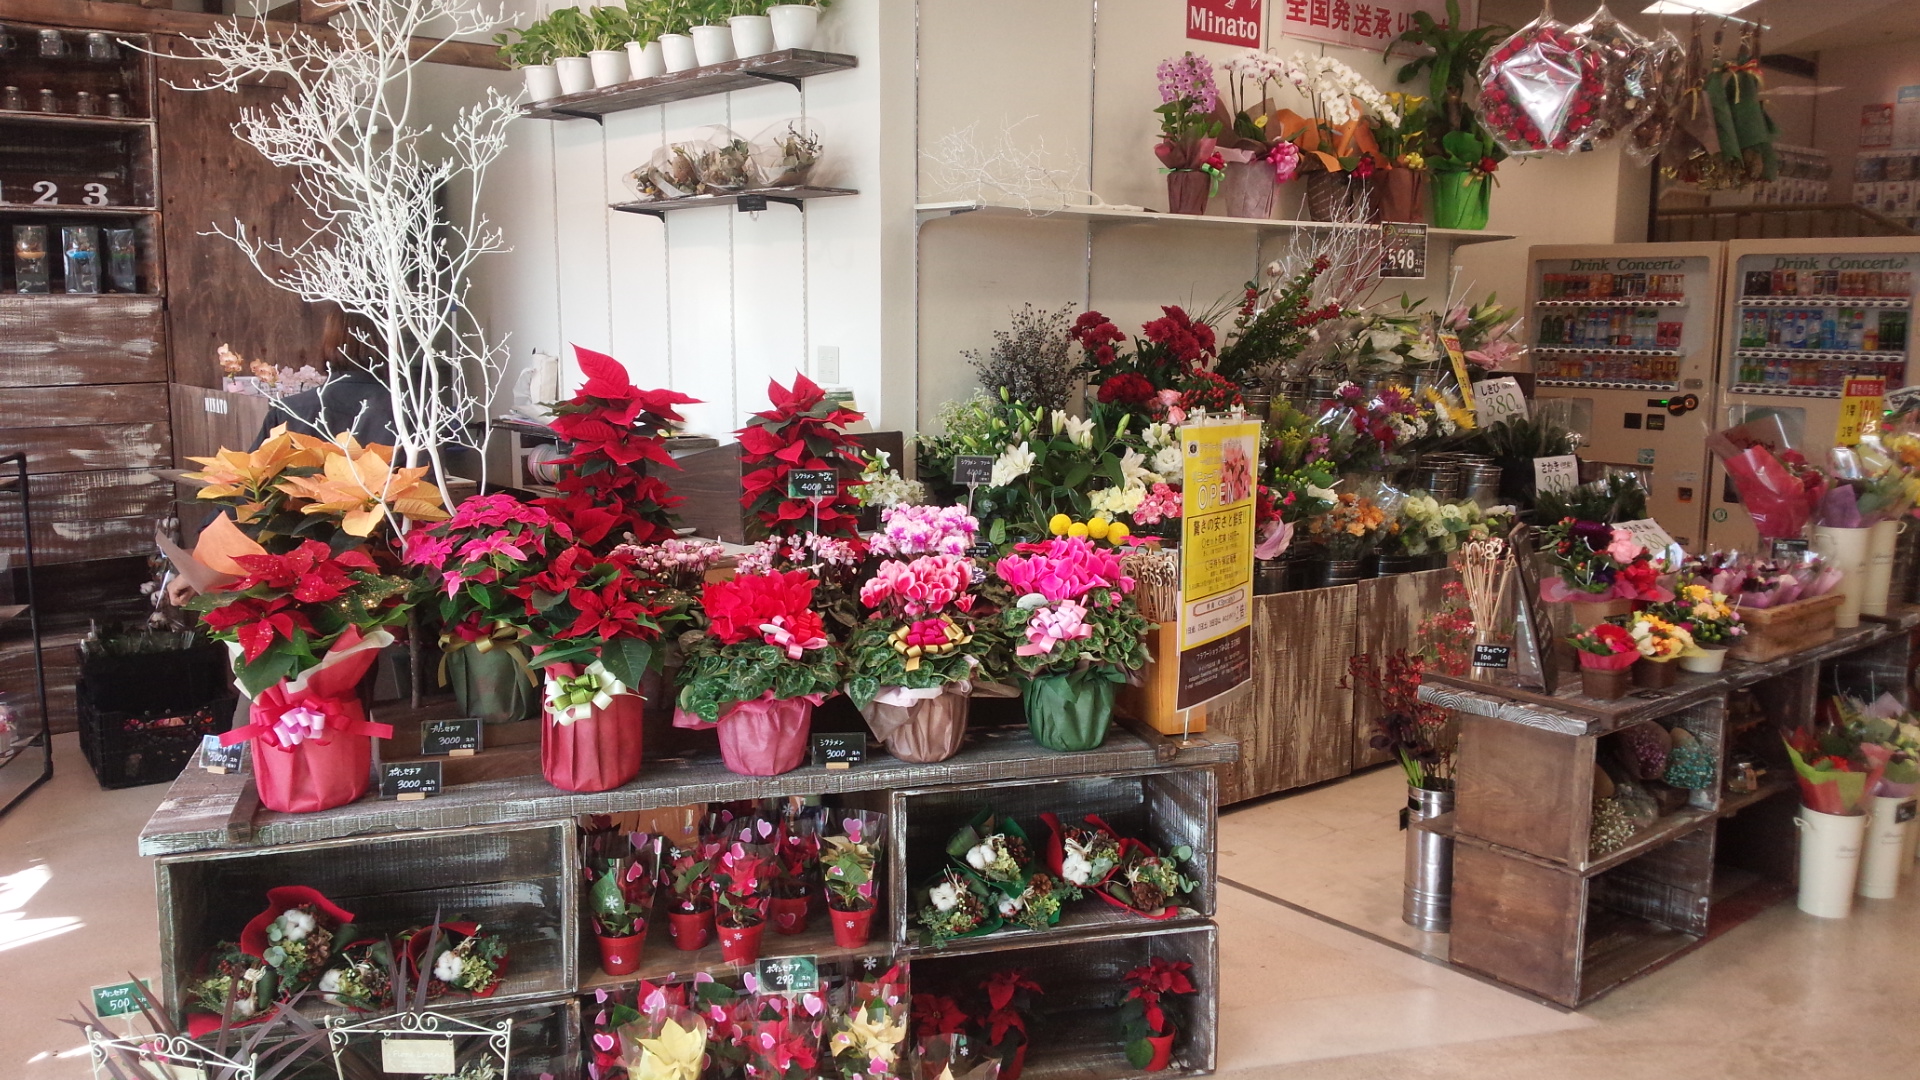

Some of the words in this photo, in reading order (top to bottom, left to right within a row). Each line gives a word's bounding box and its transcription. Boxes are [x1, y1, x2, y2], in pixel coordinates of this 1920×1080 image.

[1190, 5, 1258, 40] Minato
[33, 180, 59, 206] 2
[82, 182, 109, 207] 3
[1570, 258, 1610, 272] Drink
[1617, 258, 1685, 271] Concerto
[1774, 256, 1820, 270] Drink
[1828, 256, 1908, 270] Concerto
[1485, 392, 1516, 417] 380
[1198, 481, 1234, 511] OPEN
[439, 736, 461, 745] 3000
[826, 749, 846, 759] 3000
[388, 766, 422, 777] ポインセチア
[397, 779, 421, 790] 3000
[765, 963, 801, 974] ポインセチア
[776, 974, 794, 985] 298
[110, 998, 130, 1011] 500
